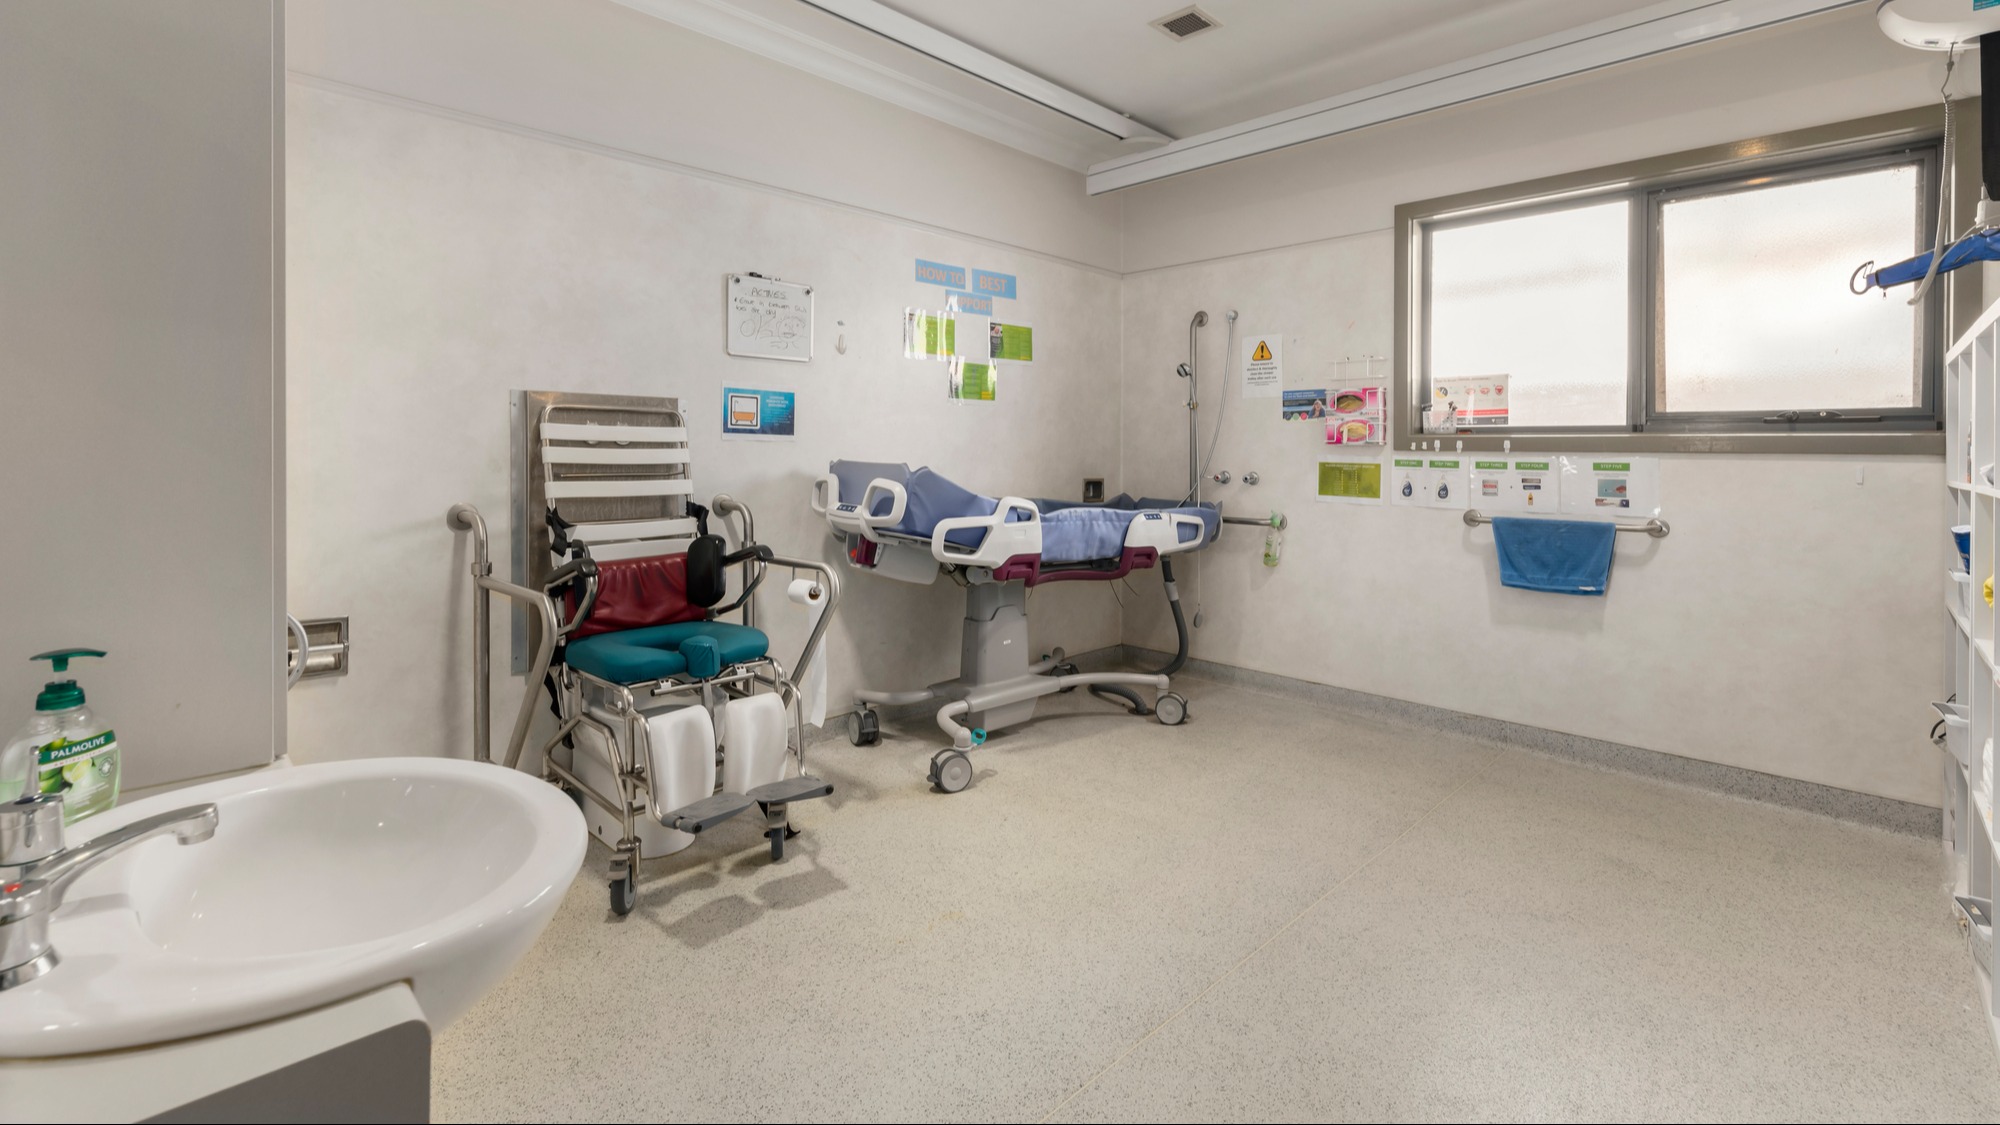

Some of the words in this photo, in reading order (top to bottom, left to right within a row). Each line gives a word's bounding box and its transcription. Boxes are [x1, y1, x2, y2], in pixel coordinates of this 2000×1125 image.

[917, 265, 947, 281] HOW
[950, 272, 965, 285] TO
[979, 275, 1008, 292] BEST
[945, 295, 992, 311] PPORT
[50, 735, 106, 760] PALMOLIVE
